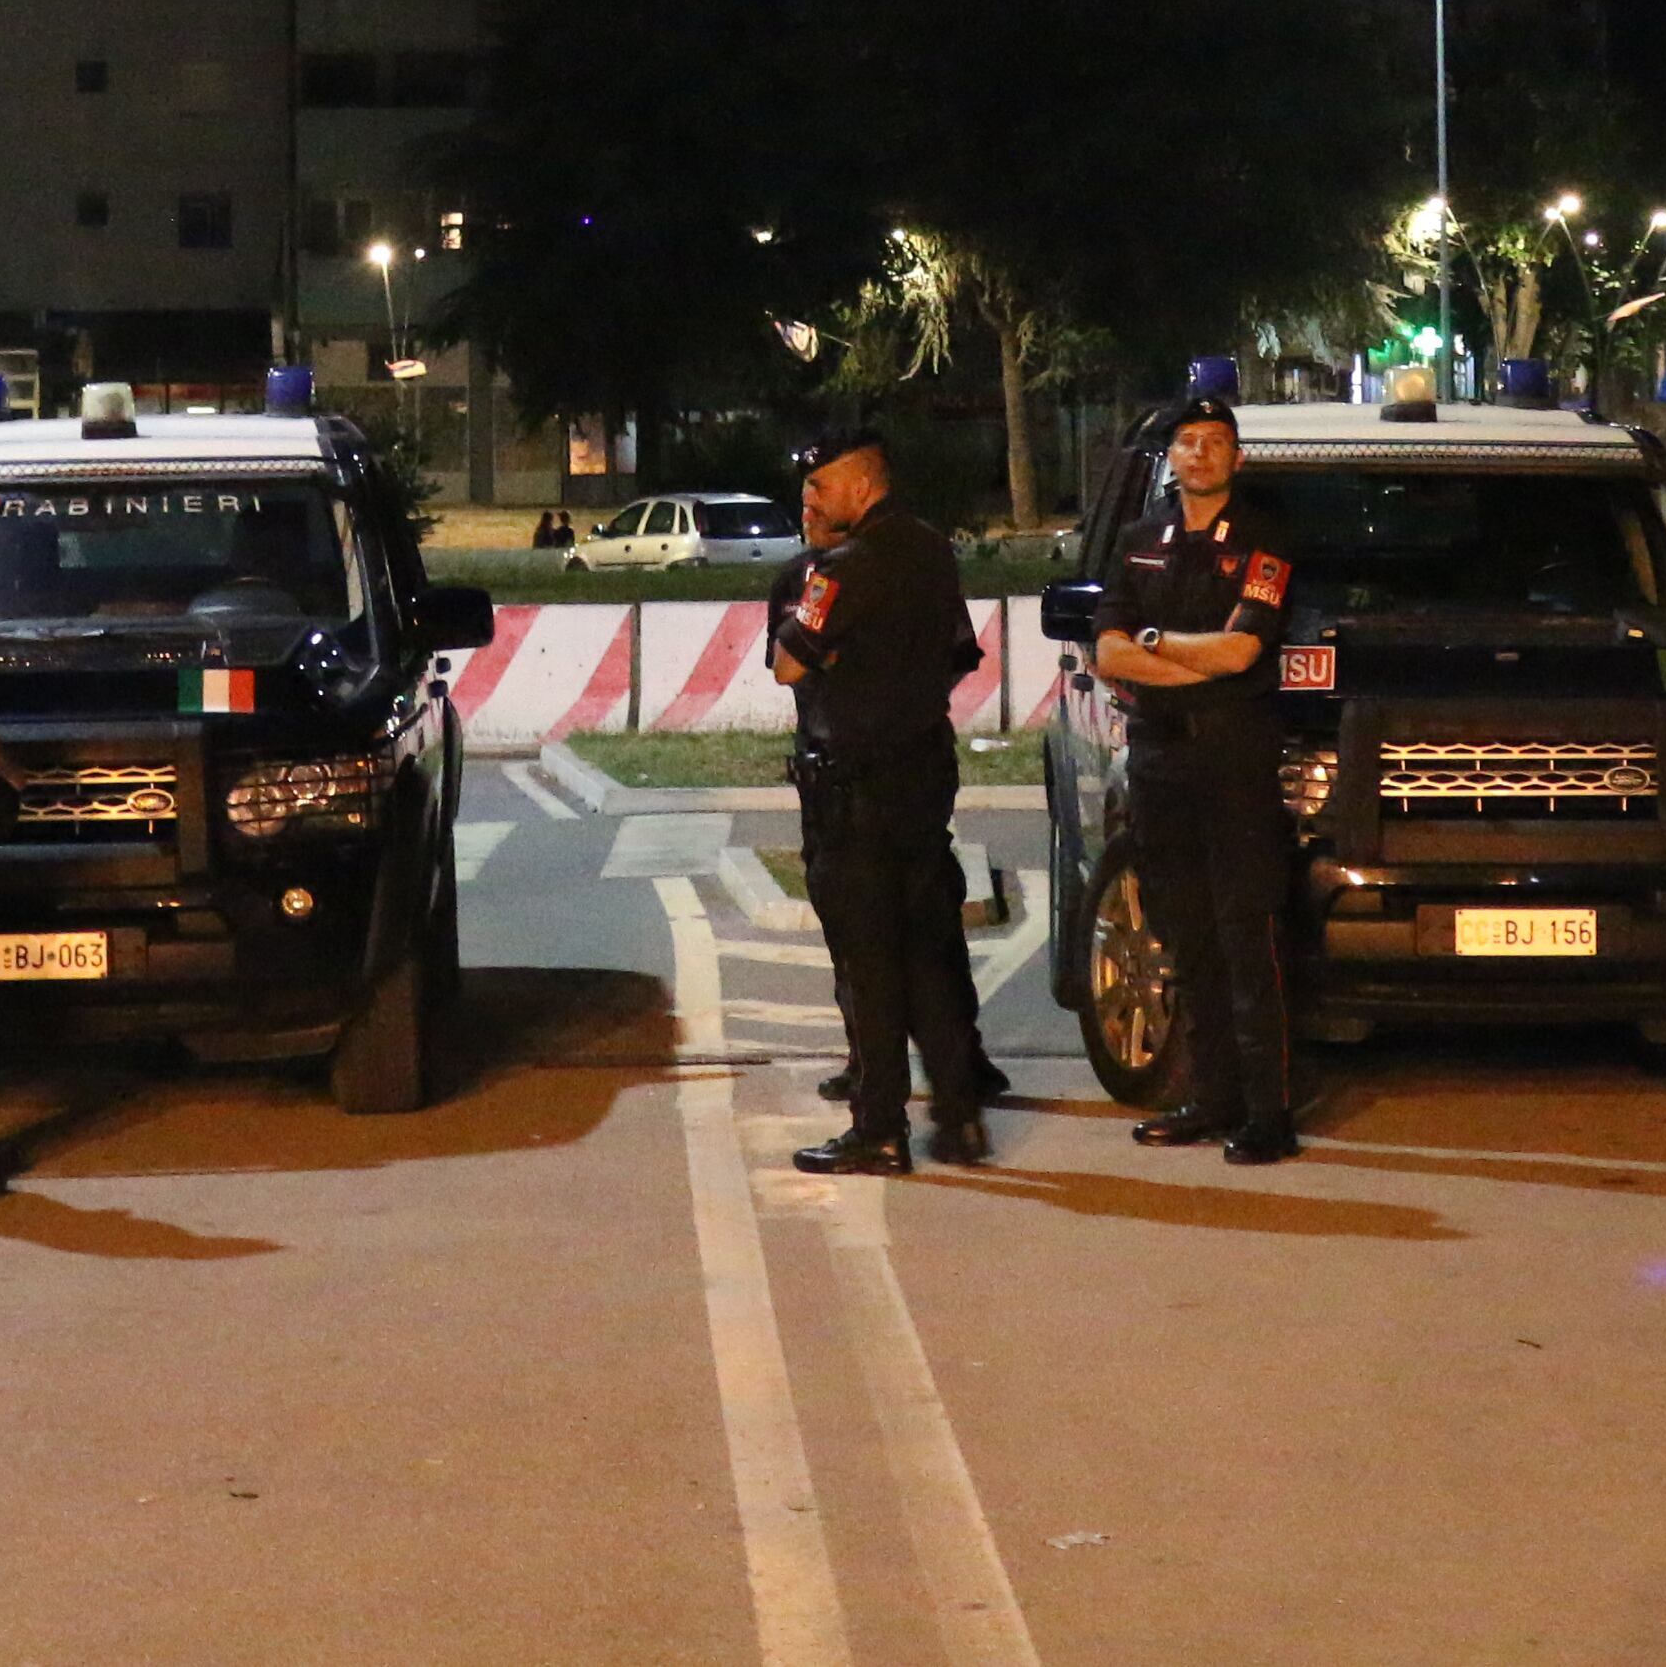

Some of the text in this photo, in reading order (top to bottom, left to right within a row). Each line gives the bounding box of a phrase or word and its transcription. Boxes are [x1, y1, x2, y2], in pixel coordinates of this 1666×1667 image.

[1, 494, 261, 518] RABINIERI
[1244, 583, 1281, 606] MSU
[795, 606, 824, 630] MSU
[1505, 919, 1534, 945] BJ
[1550, 919, 1593, 945] 156
[15, 944, 45, 969] BJ
[59, 943, 103, 968] 063
